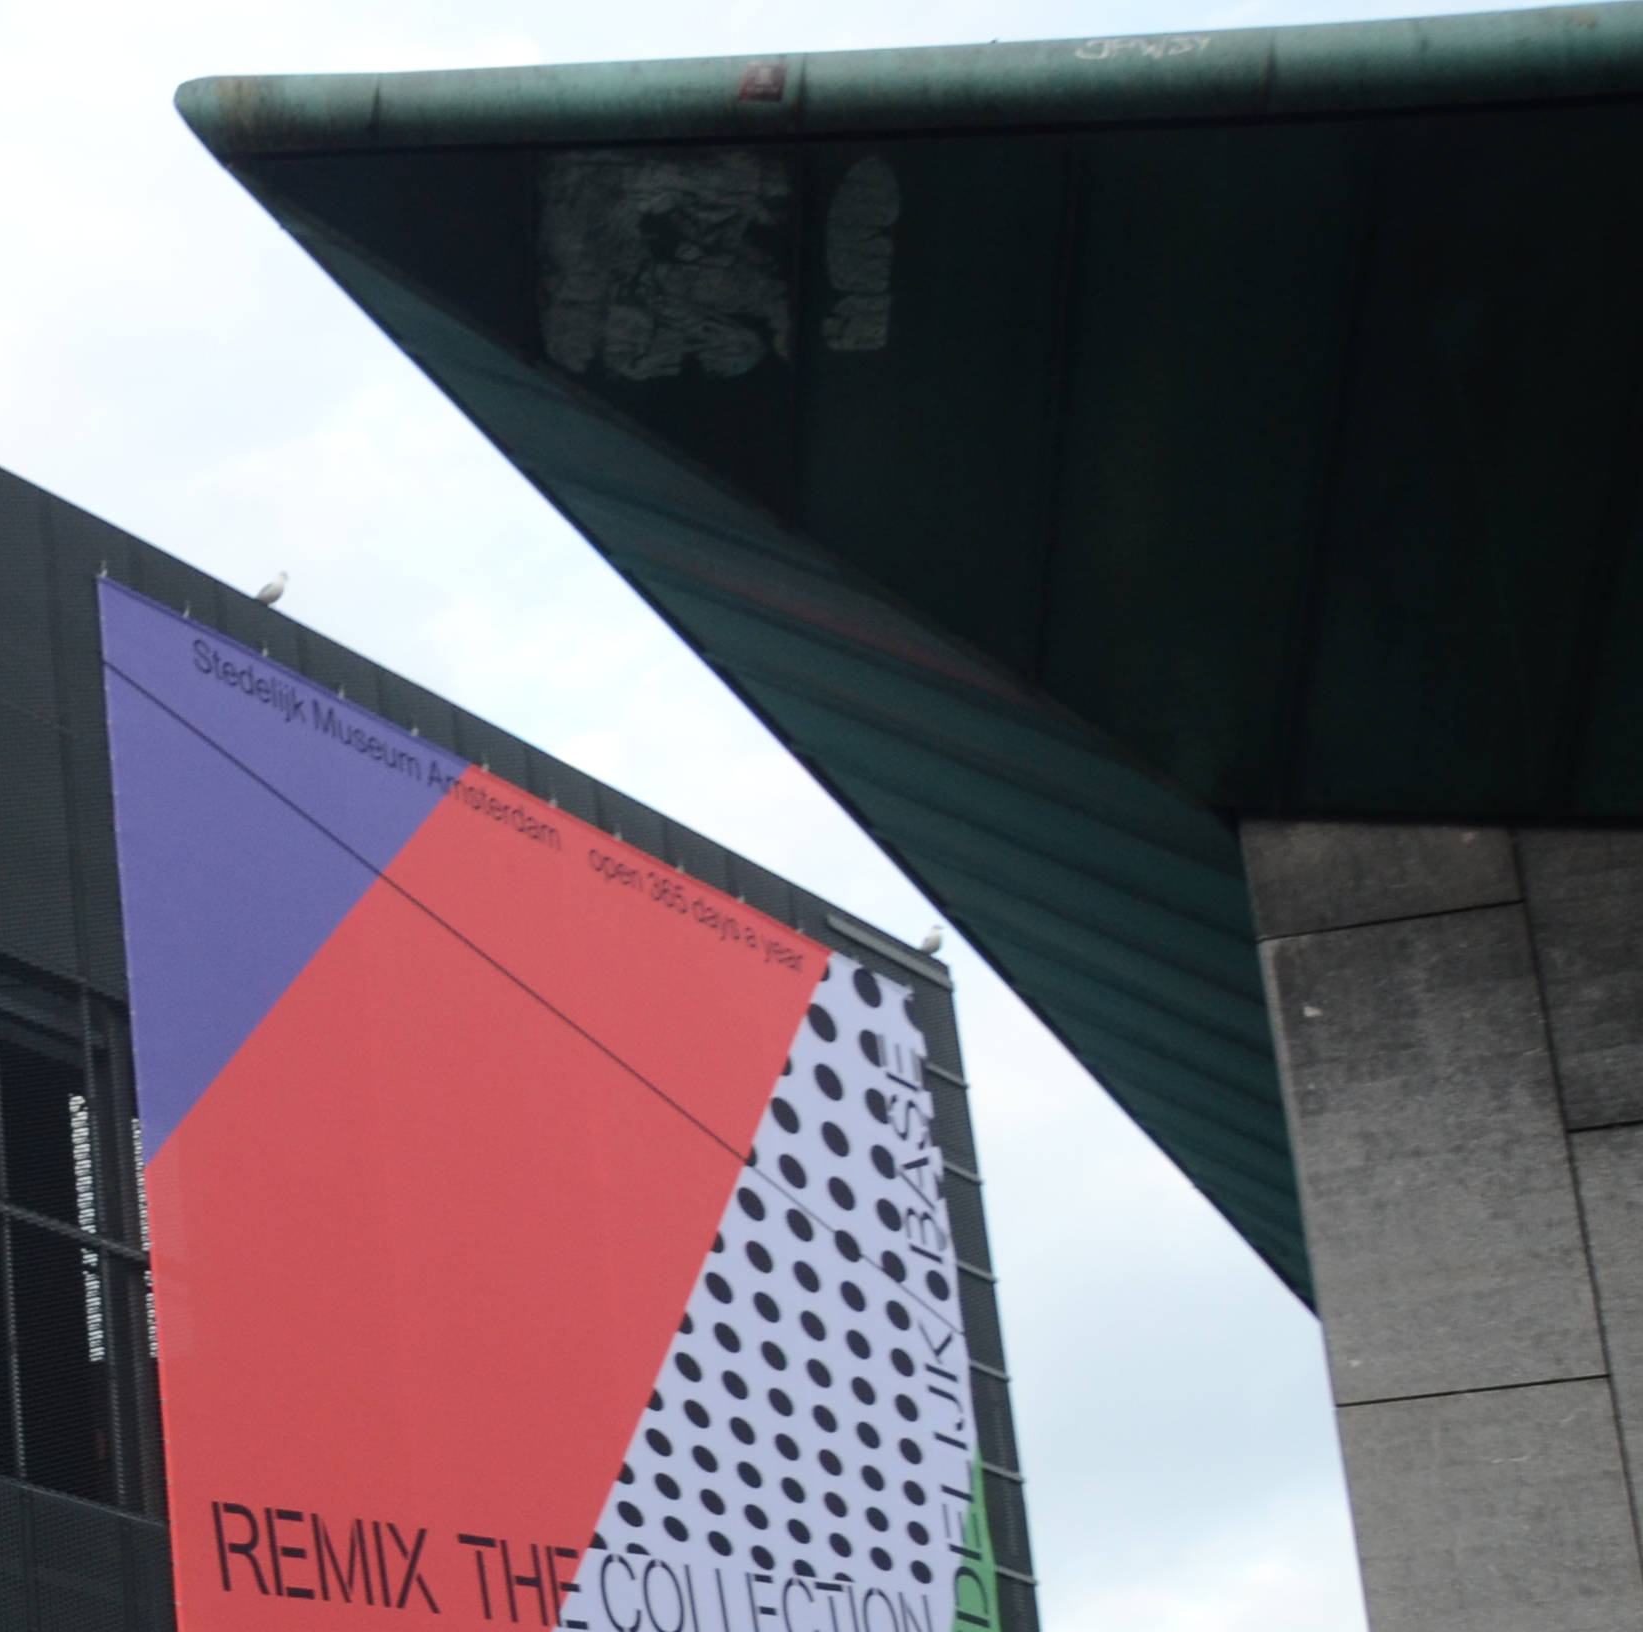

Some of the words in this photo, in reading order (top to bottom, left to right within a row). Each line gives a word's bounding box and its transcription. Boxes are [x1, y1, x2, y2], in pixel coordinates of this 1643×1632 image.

[192, 638, 307, 724] Stedelijk
[313, 700, 422, 782] Museum
[428, 759, 563, 850] Amsterdam
[588, 848, 643, 892] open
[647, 871, 689, 915] 365
[692, 898, 741, 942] days
[744, 925, 757, 949] a
[212, 1500, 441, 1614] REMIX
[458, 1532, 590, 1630] THE
